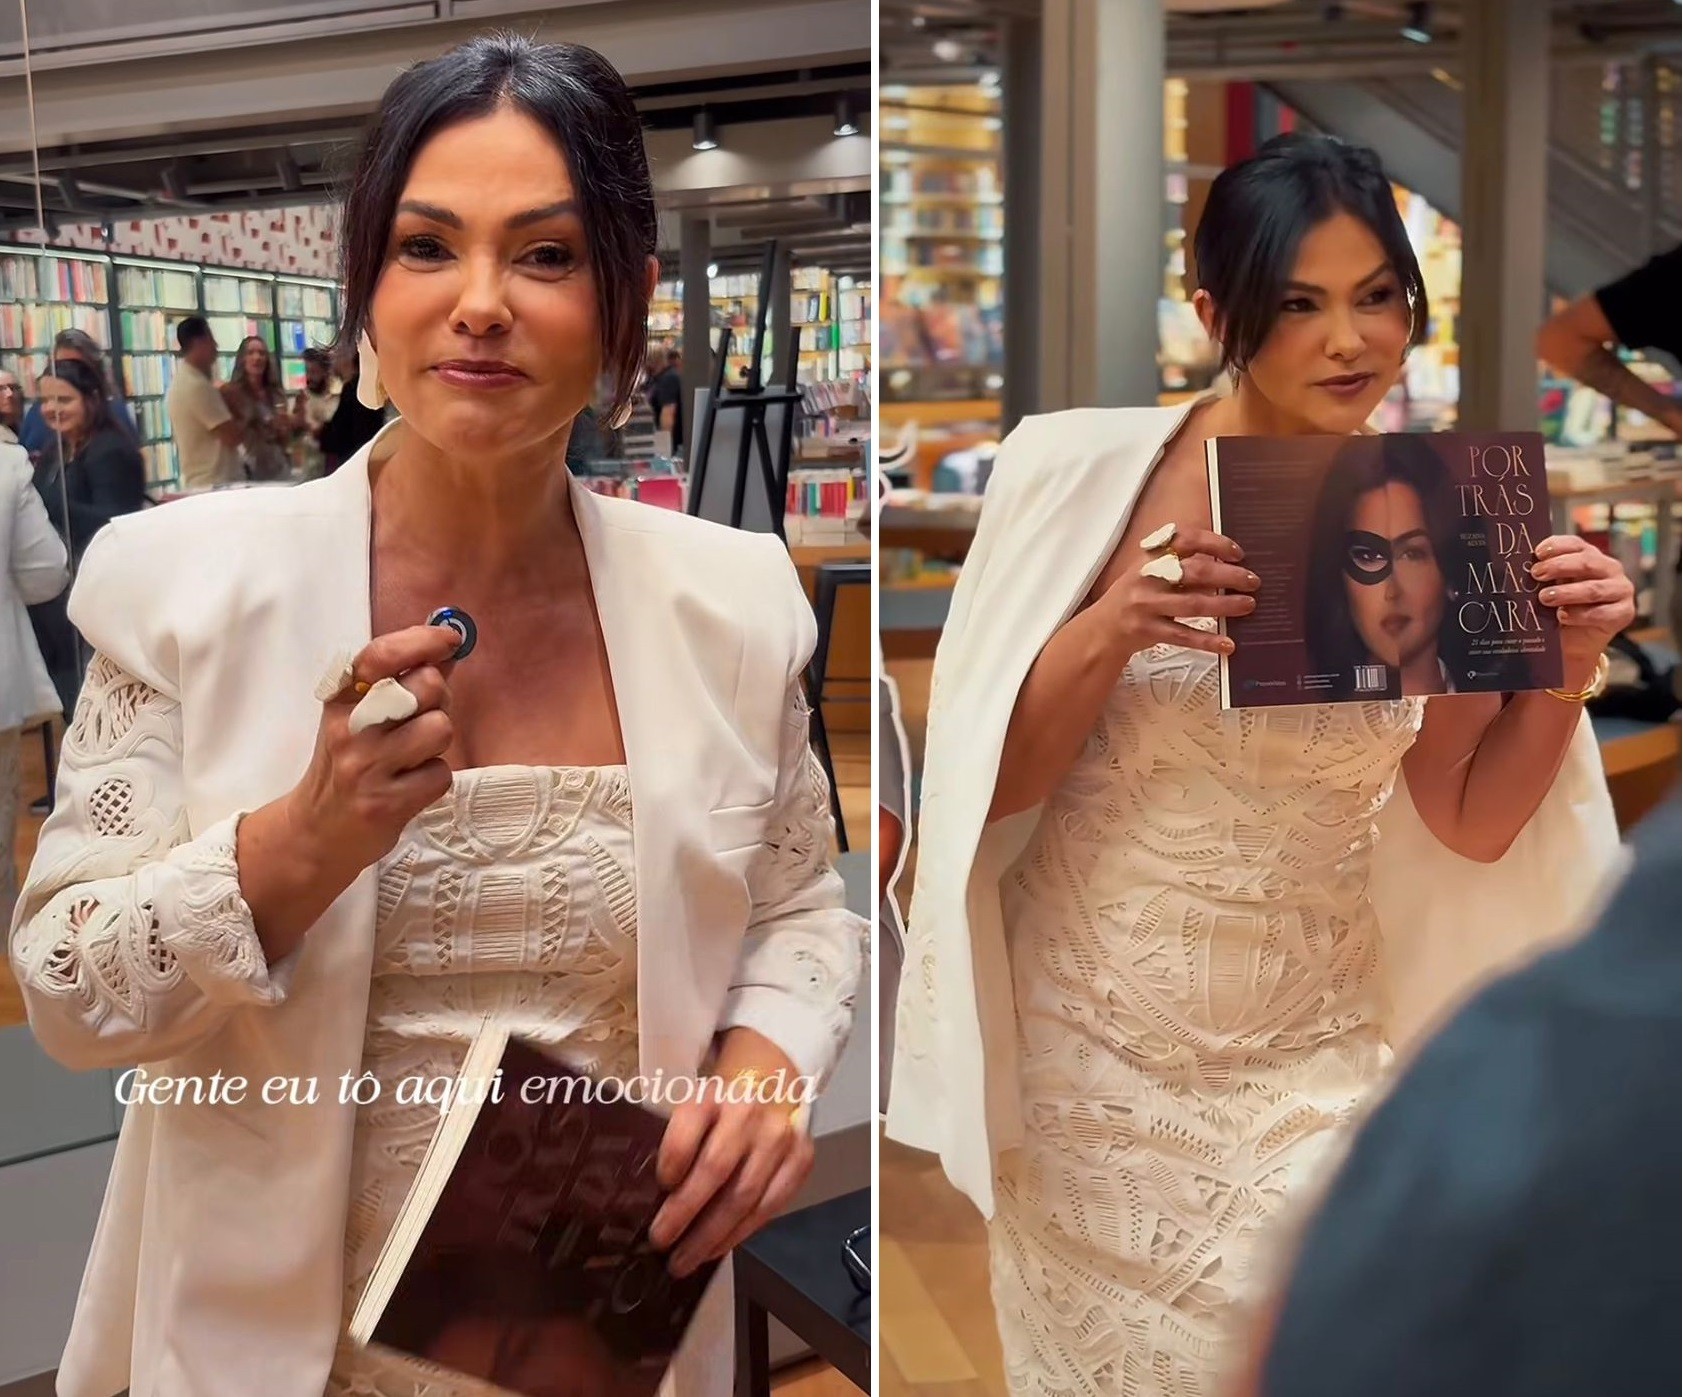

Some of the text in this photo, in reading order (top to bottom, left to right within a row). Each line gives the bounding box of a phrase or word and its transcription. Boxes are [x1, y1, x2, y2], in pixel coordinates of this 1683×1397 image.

[1469, 445, 1532, 478] POR
[1455, 476, 1534, 517] TRÁS
[1496, 522, 1535, 555] DA
[1465, 553, 1541, 595] MÁS
[1458, 599, 1543, 635] CARA
